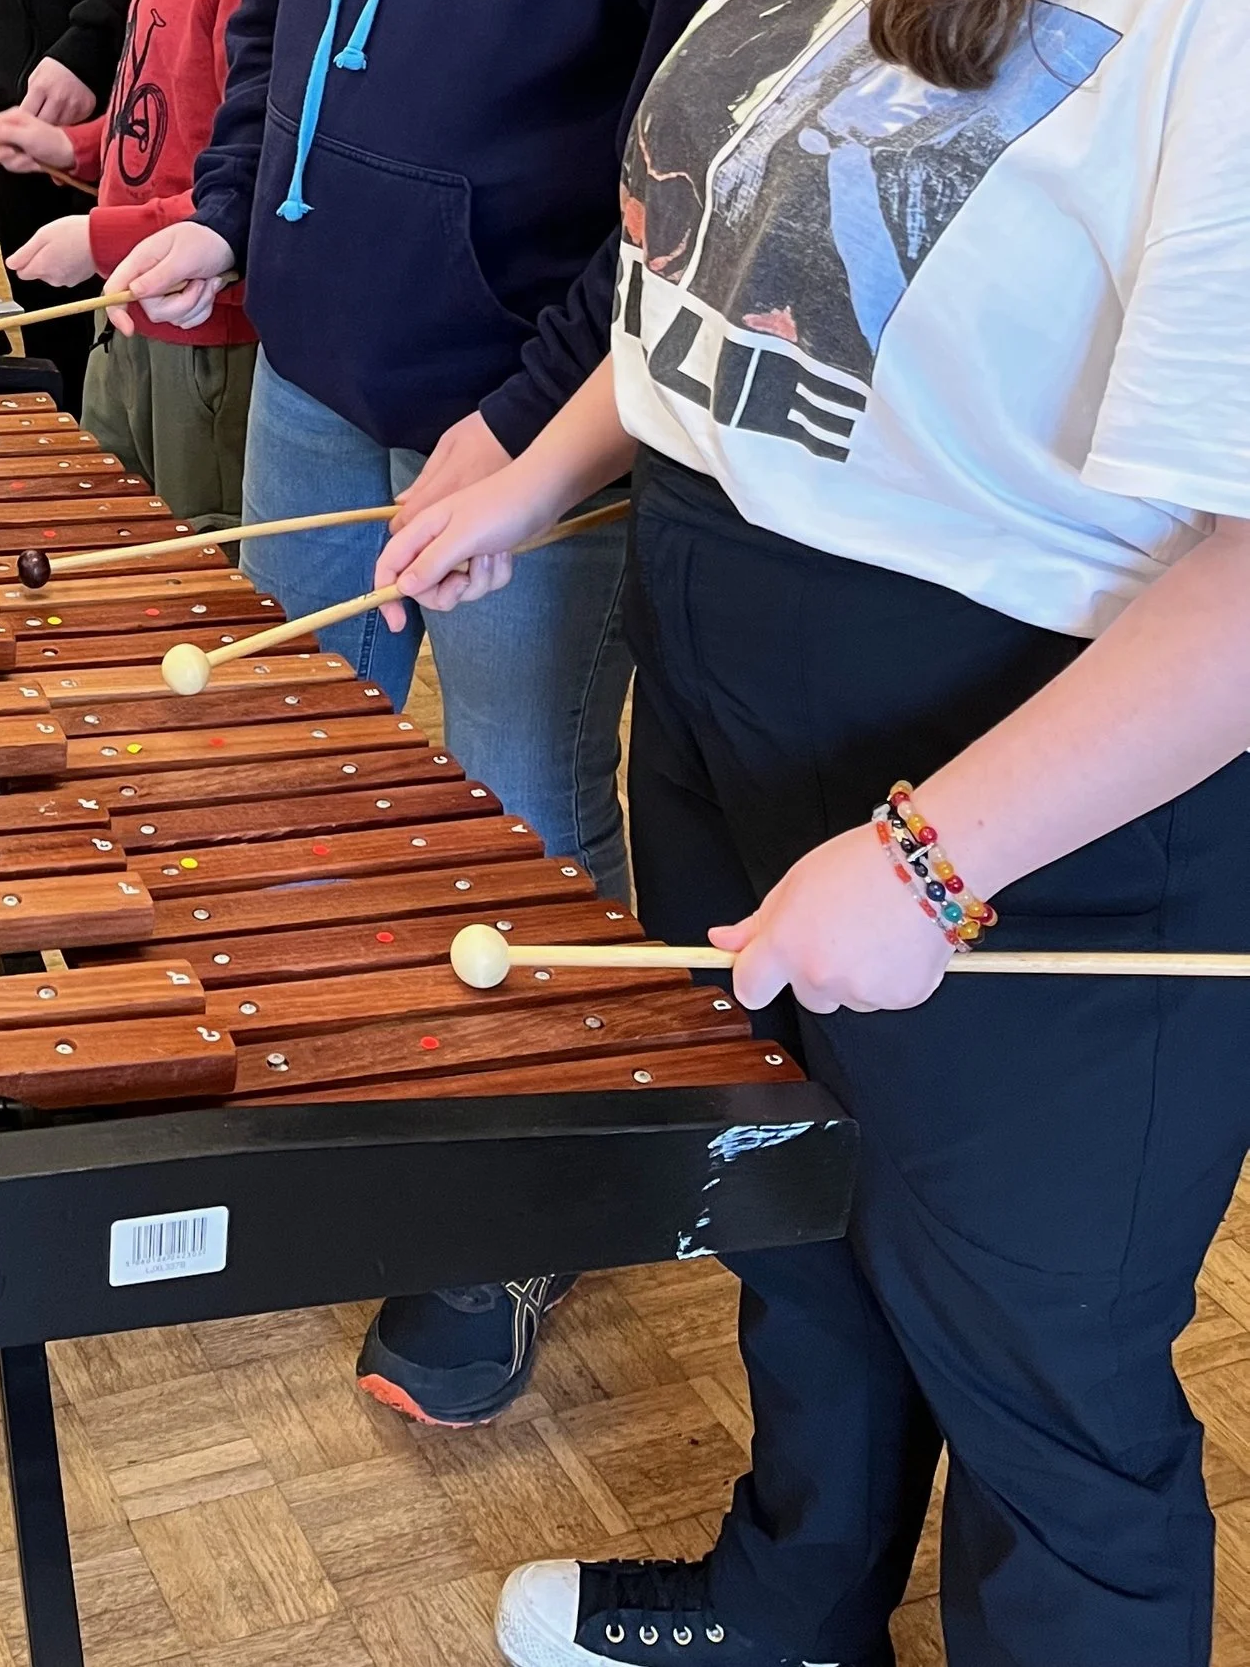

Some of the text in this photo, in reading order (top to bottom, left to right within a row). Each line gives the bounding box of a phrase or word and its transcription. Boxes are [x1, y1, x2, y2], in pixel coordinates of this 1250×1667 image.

[260, 599, 275, 607] A
[364, 688, 380, 696] E
[398, 722, 414, 731] D
[433, 755, 448, 764] C
[470, 788, 487, 798] B
[511, 824, 528, 833] A
[605, 911, 624, 920] F
[712, 999, 732, 1011] D
[764, 1054, 783, 1065] C
